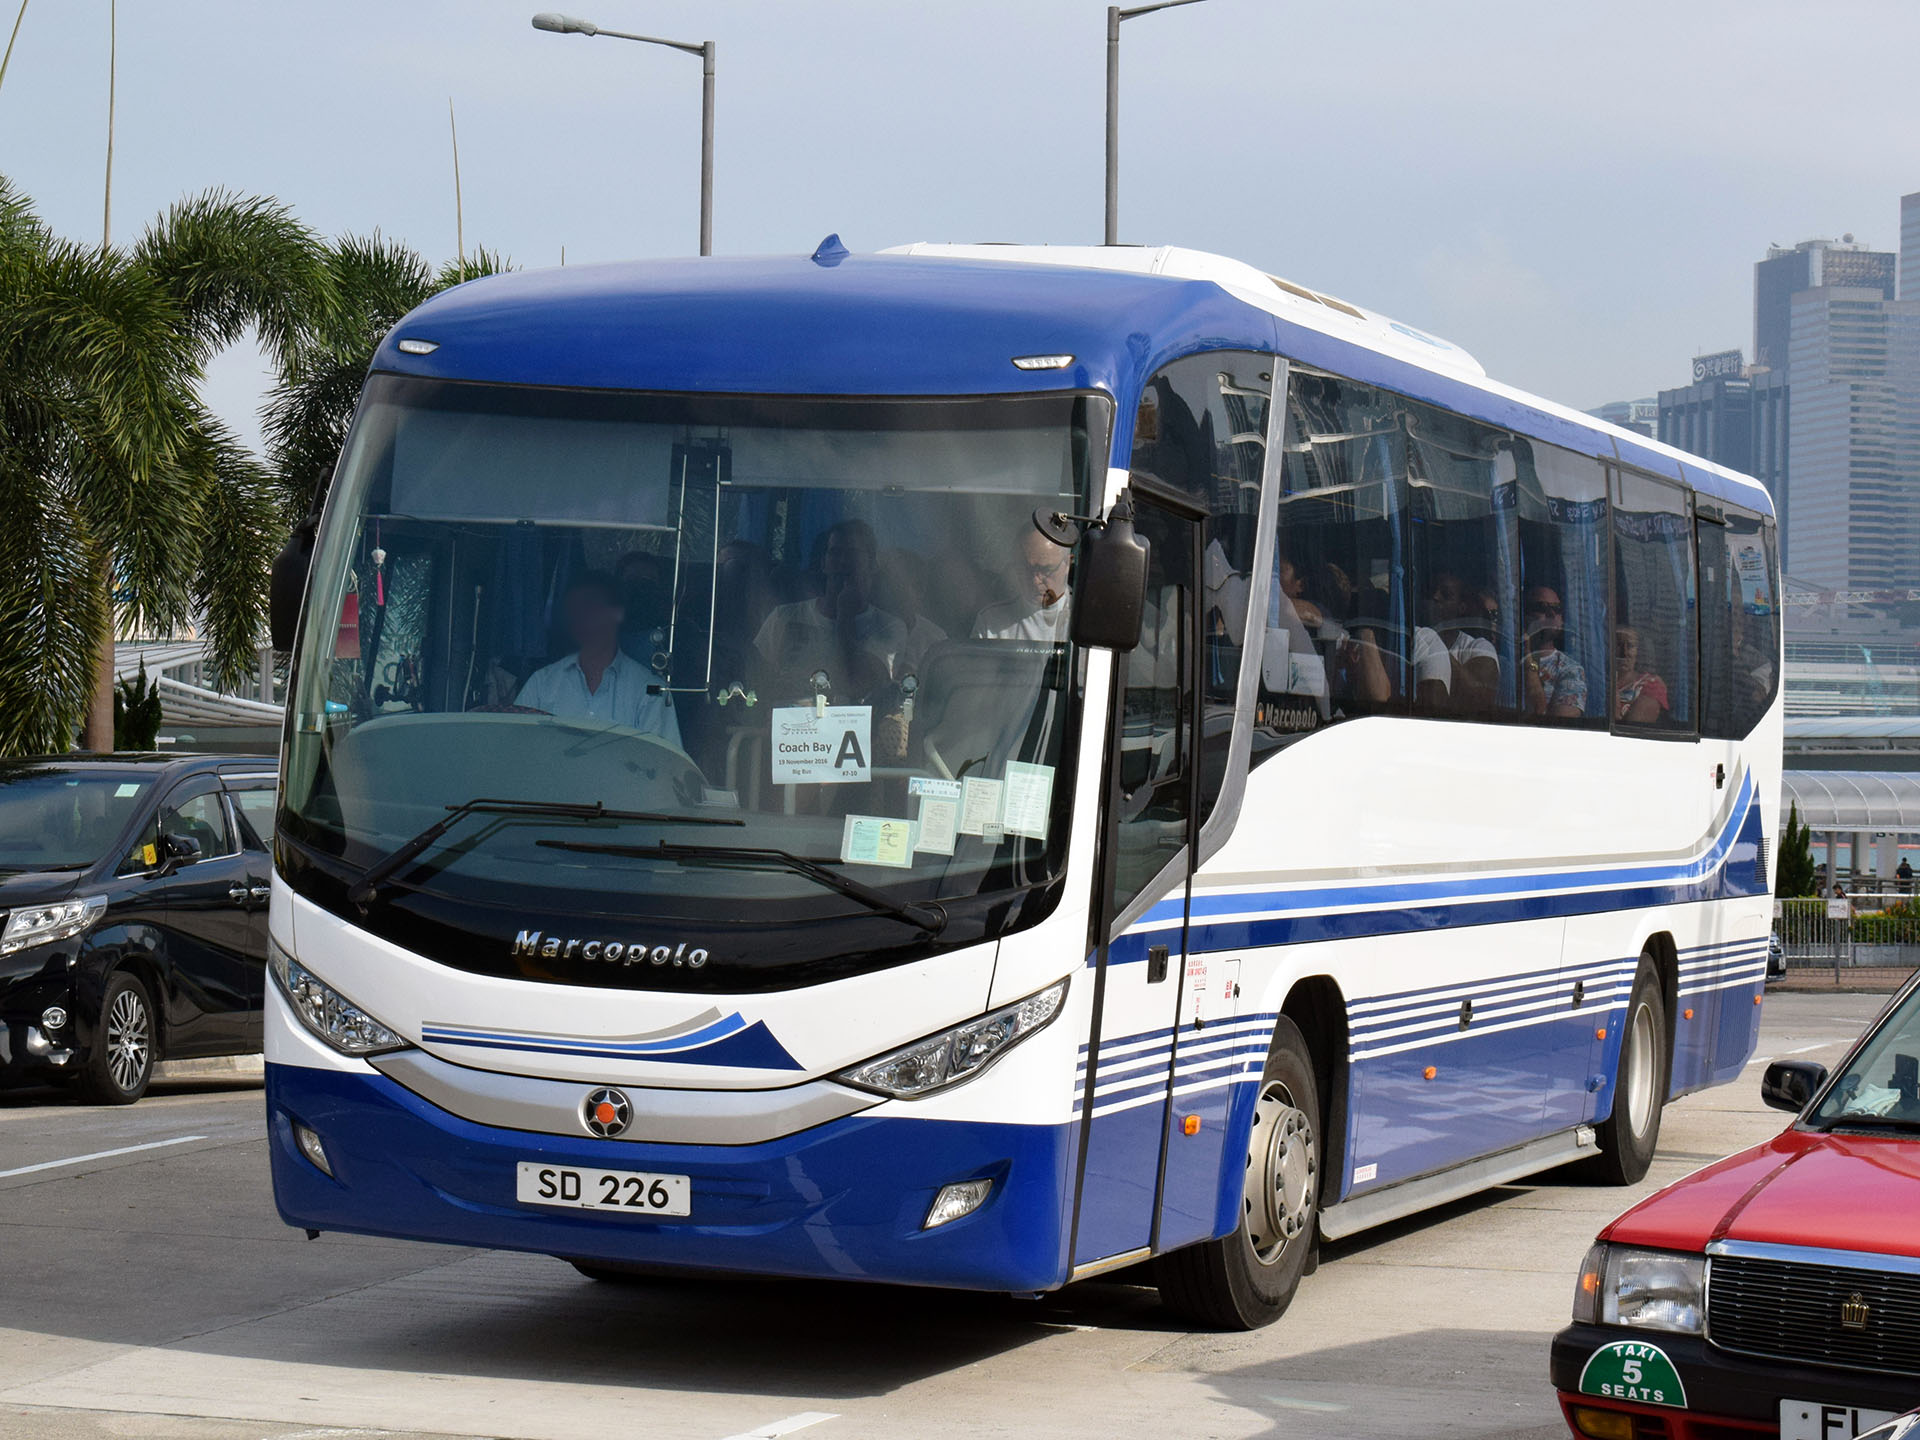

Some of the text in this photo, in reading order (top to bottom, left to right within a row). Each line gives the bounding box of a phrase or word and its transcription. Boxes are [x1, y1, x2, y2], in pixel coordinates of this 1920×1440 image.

[1265, 703, 1318, 731] Marcopolo
[778, 742, 832, 754] Coach Bay
[834, 730, 866, 768] A
[511, 930, 709, 968] Marcopolo
[537, 1169, 669, 1209] SD 226
[1613, 1344, 1656, 1362] TAXI
[1622, 1359, 1642, 1384] 5
[1601, 1383, 1664, 1402] SEATS
